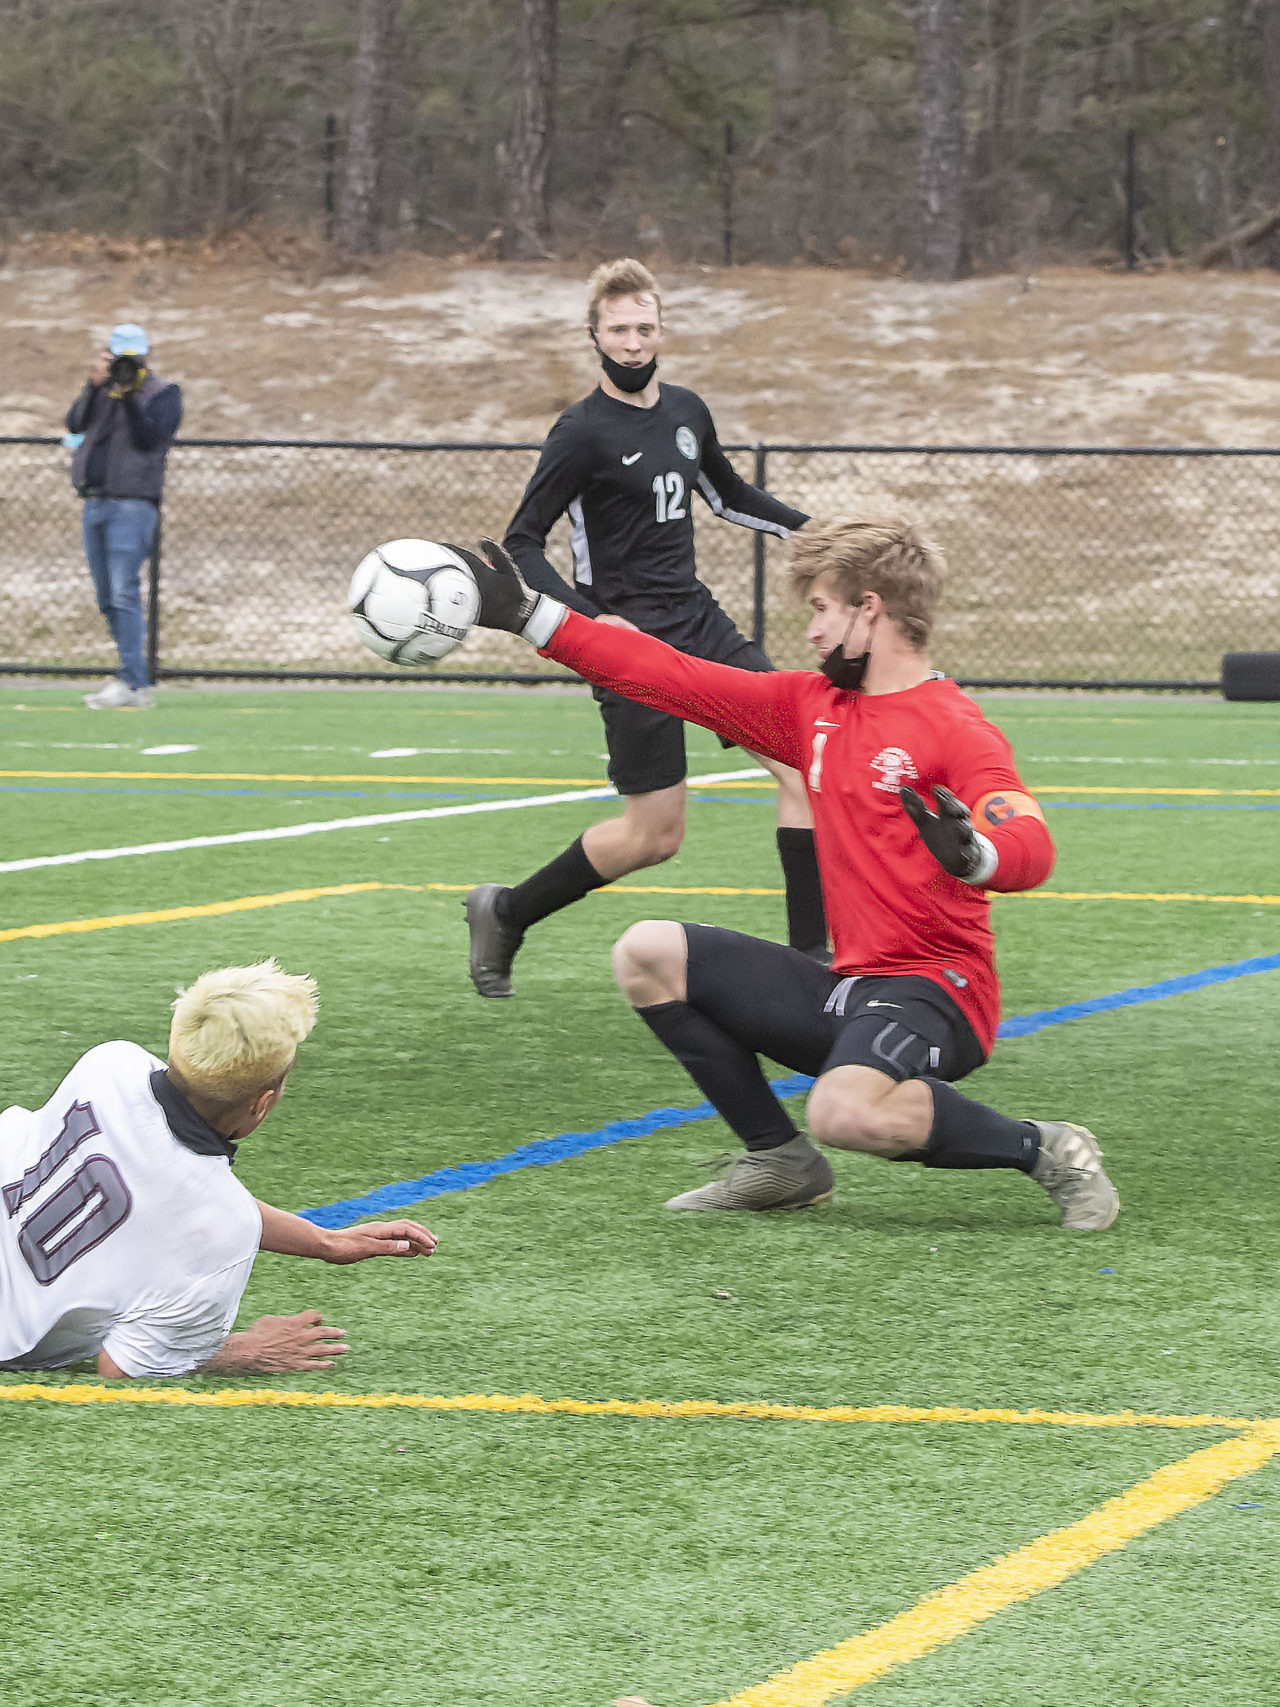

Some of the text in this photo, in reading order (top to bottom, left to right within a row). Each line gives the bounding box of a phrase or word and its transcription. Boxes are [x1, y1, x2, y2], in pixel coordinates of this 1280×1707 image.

[652, 471, 686, 523] 12
[808, 732, 828, 793] 1
[1, 1099, 132, 1287] 10
